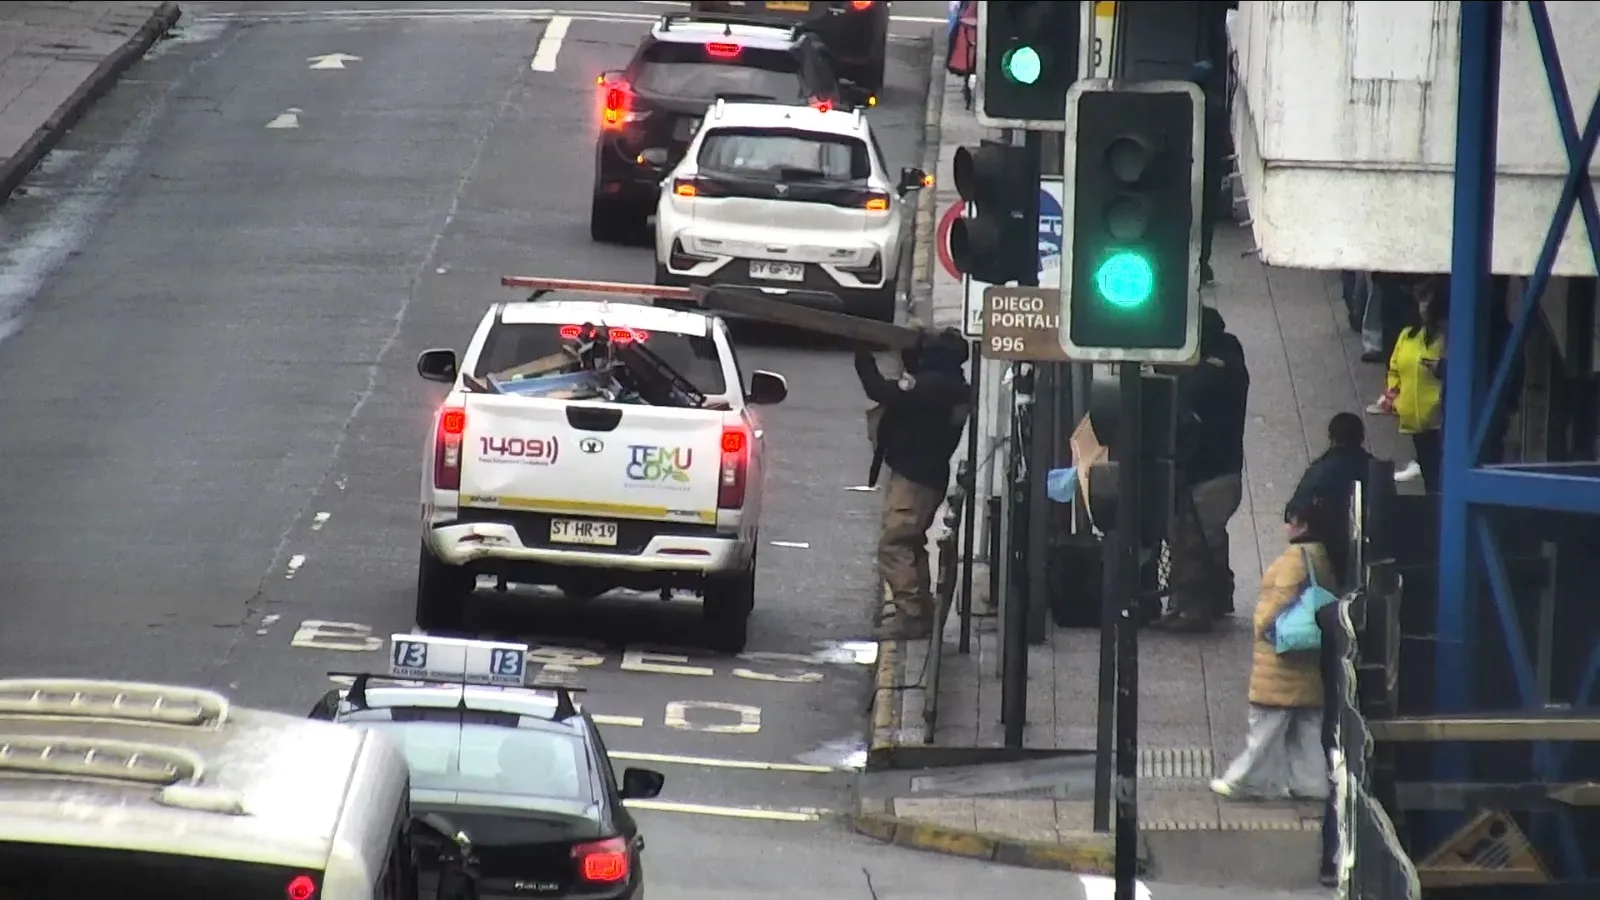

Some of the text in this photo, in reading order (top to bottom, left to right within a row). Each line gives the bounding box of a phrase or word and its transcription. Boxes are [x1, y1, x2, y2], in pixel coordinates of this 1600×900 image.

[991, 296, 1044, 312] DIEGO
[991, 336, 1025, 352] 996
[480, 436, 544, 458] 1409
[627, 445, 692, 470] TEMU
[397, 642, 426, 667] 13
[494, 649, 519, 674] 13
